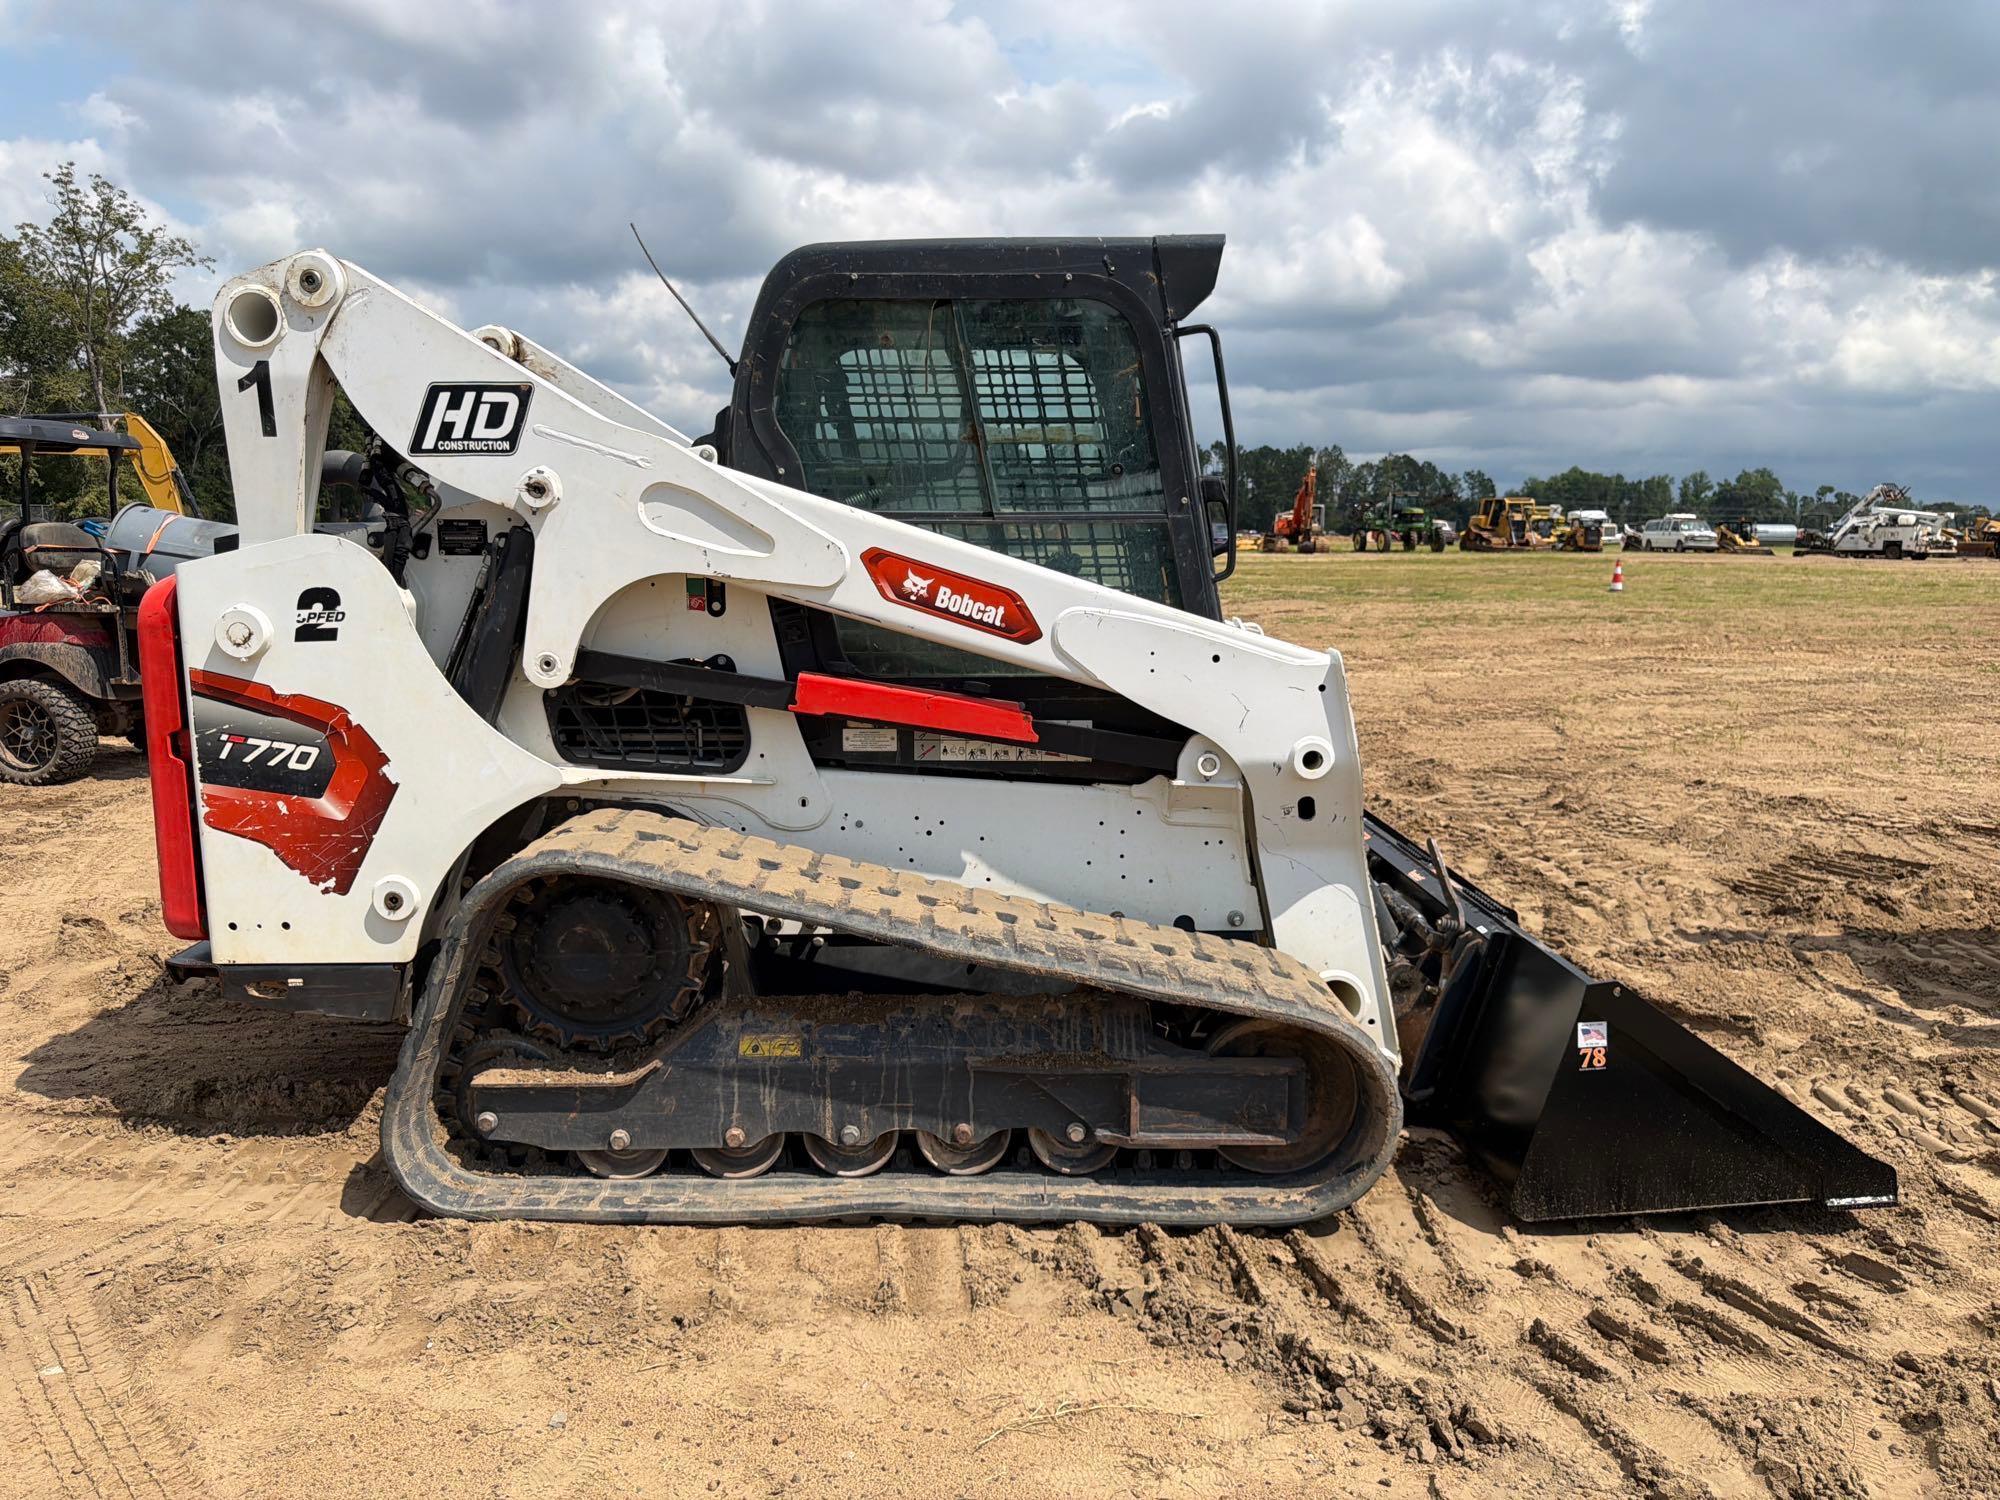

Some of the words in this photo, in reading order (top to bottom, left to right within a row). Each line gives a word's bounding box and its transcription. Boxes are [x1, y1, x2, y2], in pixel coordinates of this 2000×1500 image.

[238, 360, 278, 437] 1
[421, 391, 520, 450] HD
[437, 440, 511, 451] CONSTRUCTION
[294, 586, 342, 643] 2
[934, 585, 1006, 628] Bobcat
[219, 733, 321, 771] T770
[1579, 1046, 1607, 1068] 78
